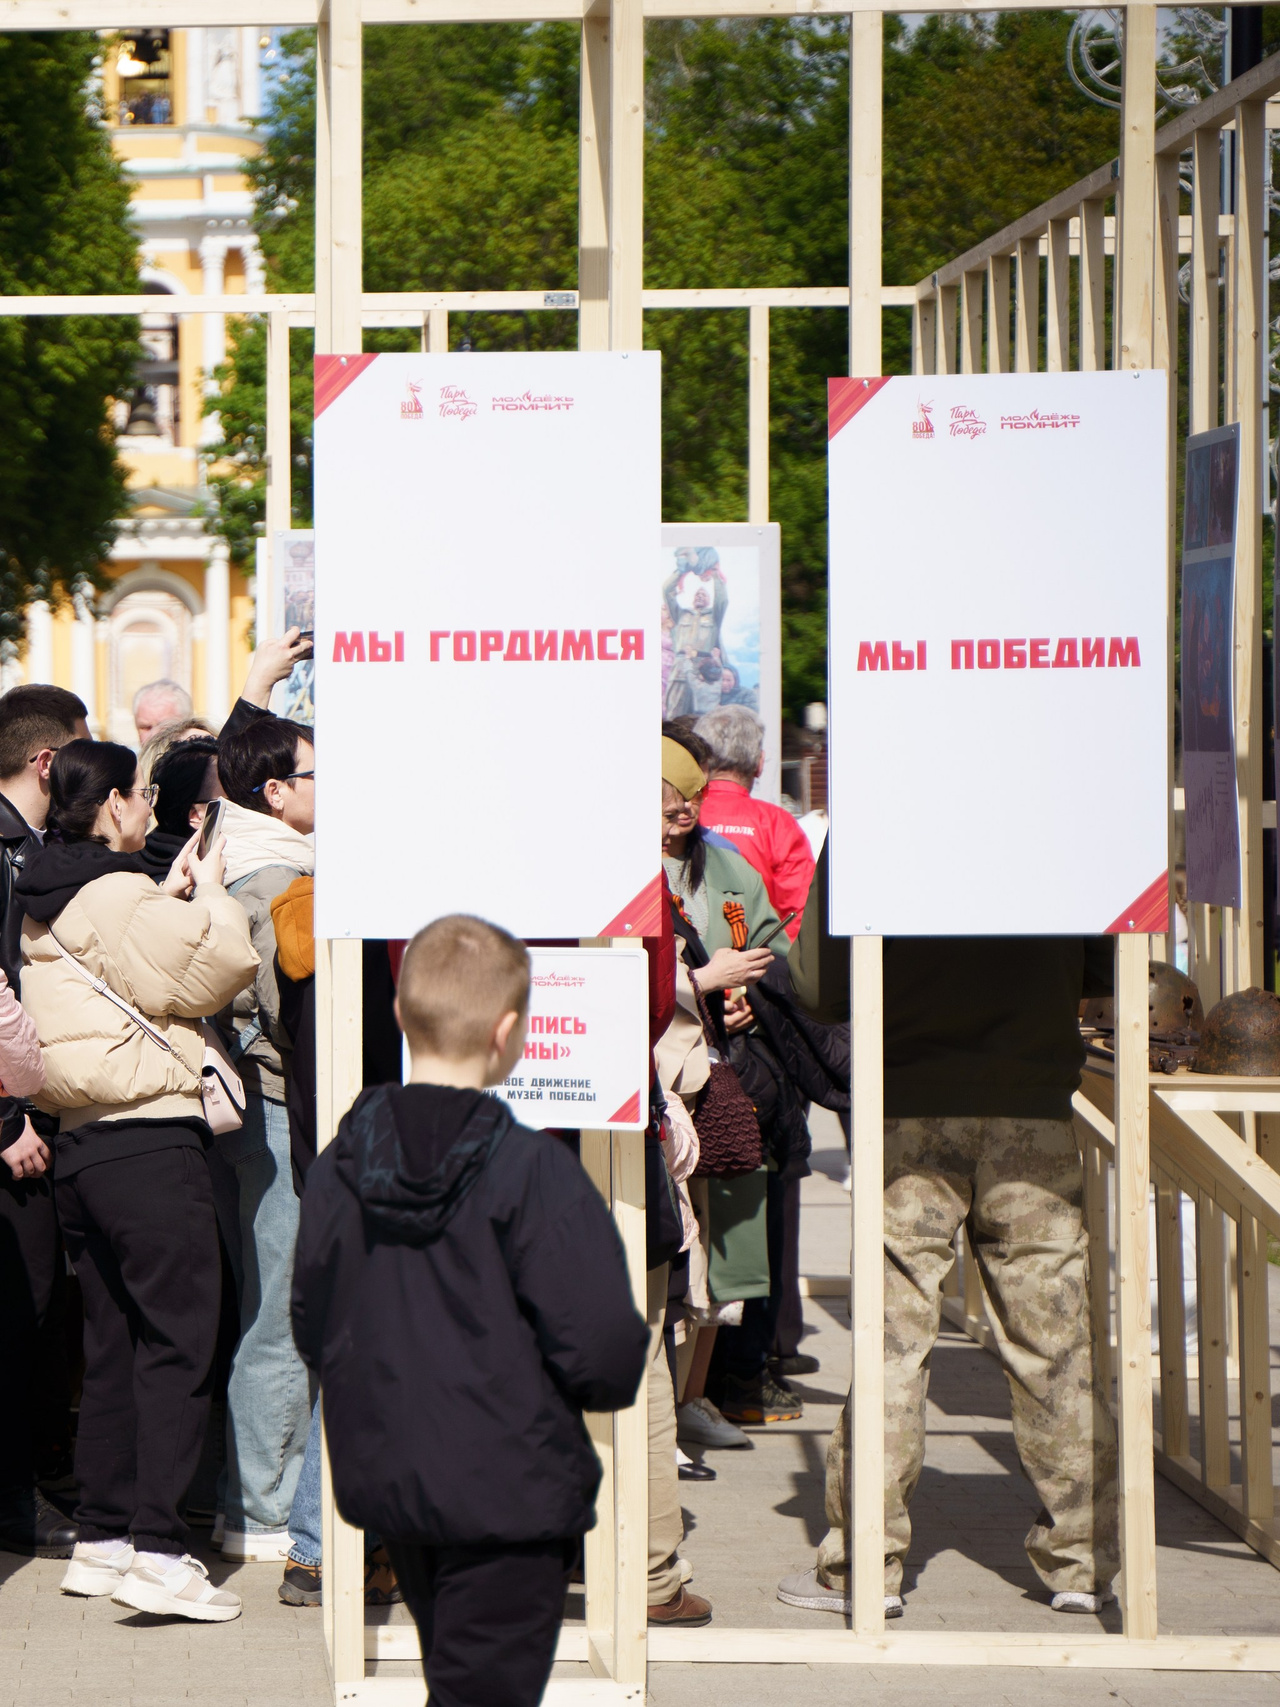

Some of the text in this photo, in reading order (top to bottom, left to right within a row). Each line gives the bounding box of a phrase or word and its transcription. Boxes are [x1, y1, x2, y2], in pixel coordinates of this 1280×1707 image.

[440, 385, 470, 403] Парк
[492, 403, 574, 411] ПОМНИТ
[950, 405, 980, 423] Парк
[1001, 421, 1080, 430] ПОМНИТ
[332, 629, 644, 662] МЫ ГОРДИМСЯ
[857, 637, 1141, 671] МЫ ПОБЕДИМ
[526, 1015, 587, 1034] ПИСЬ
[520, 1042, 571, 1061] НЫ»
[497, 1077, 591, 1089] ВОЕ ДВИЖЕНИЕ
[507, 1088, 543, 1100] МУЗЕЙ
[549, 1091, 596, 1101] ПОБЕДЫ
